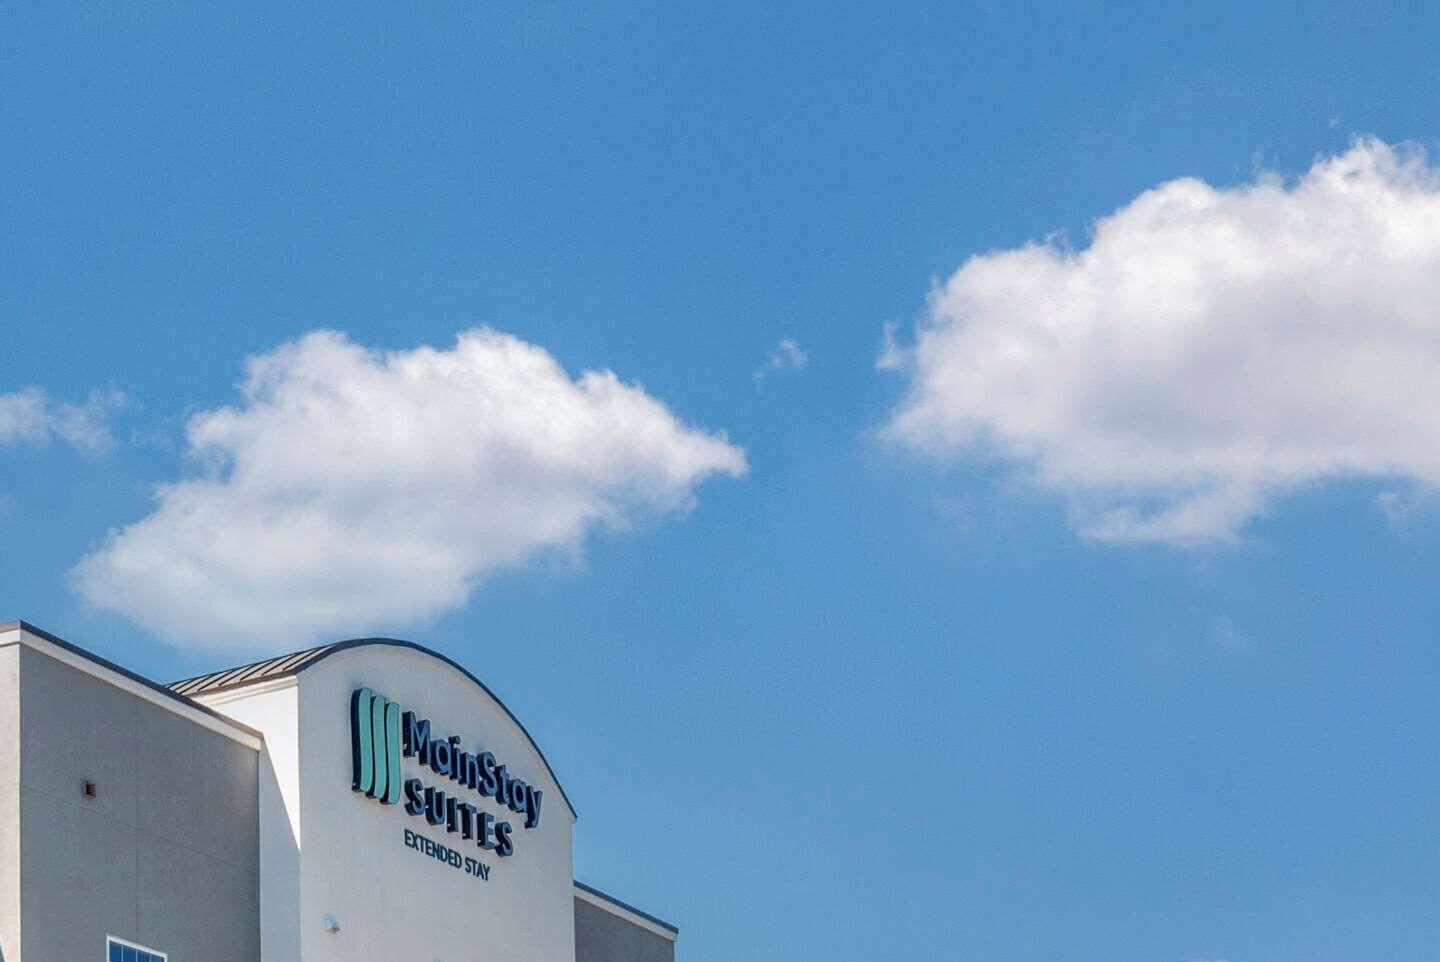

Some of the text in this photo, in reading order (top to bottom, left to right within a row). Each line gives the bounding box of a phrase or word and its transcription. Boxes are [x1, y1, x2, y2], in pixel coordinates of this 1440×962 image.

[402, 711, 543, 829] MainStay
[404, 778, 513, 857] SUITES
[404, 828, 490, 881] EXTENDED STAY
